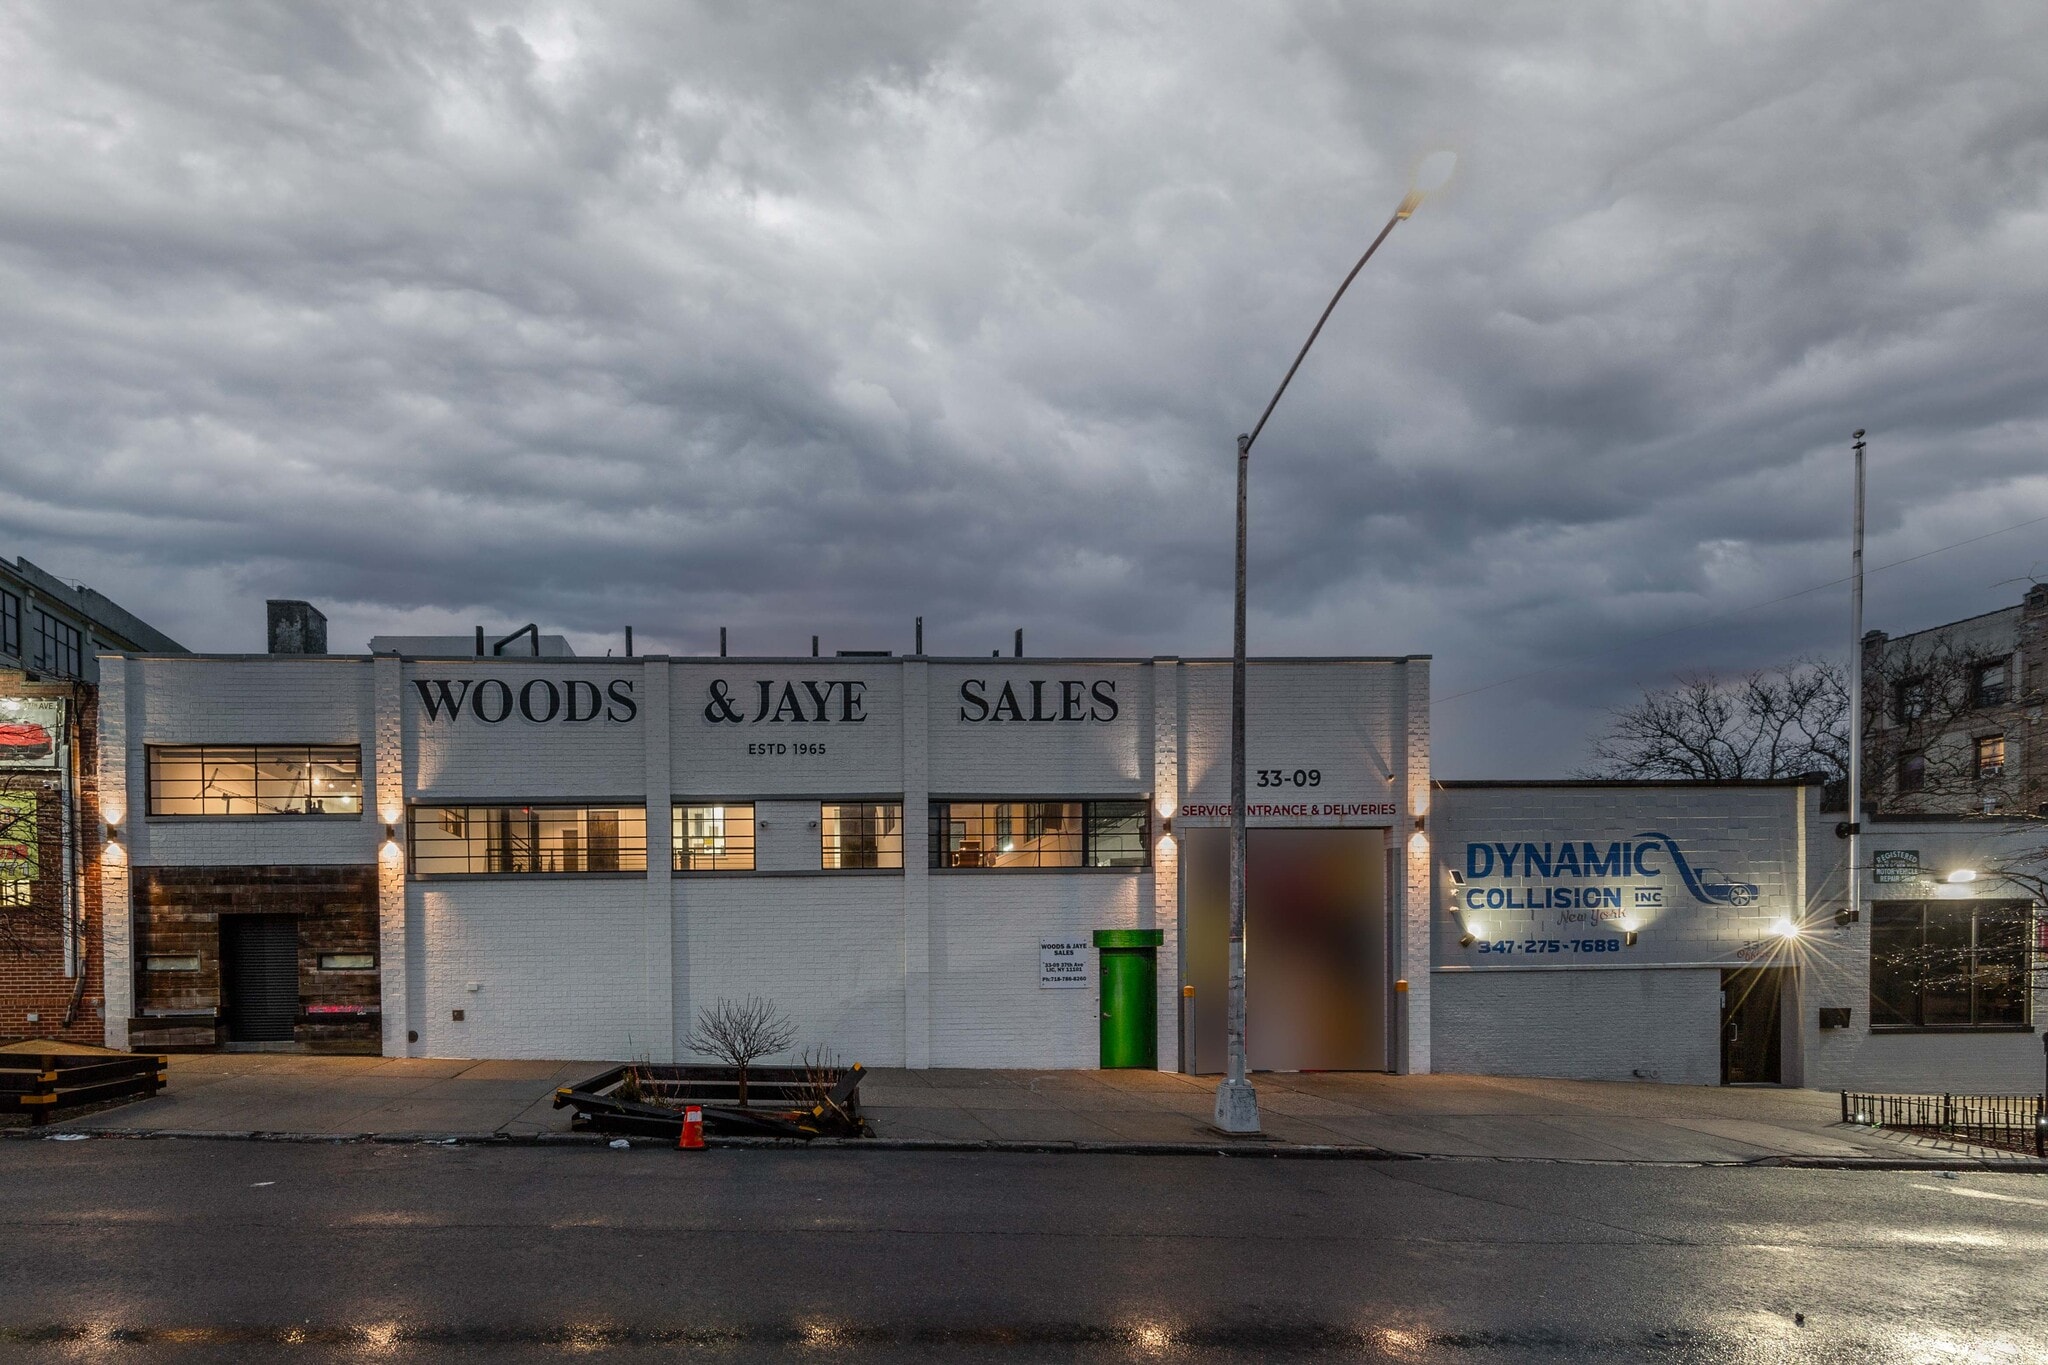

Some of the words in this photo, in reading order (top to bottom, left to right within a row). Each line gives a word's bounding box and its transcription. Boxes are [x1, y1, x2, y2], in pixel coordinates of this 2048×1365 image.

[411, 679, 637, 723] WOODS
[704, 679, 745, 723] &
[752, 680, 868, 723] JAYE
[960, 679, 1119, 722] SALES
[749, 743, 787, 755] ESTD
[794, 743, 826, 755] 1965
[1256, 769, 1321, 787] 33-09
[1247, 804, 1307, 816] NTRANCE
[1311, 805, 1320, 816] &
[1323, 804, 1397, 816] DELIVERIES
[1467, 842, 1661, 878] DYNAMIC
[1876, 851, 1918, 863] REGISTERED
[1466, 887, 1621, 909] COLLISION
[1635, 892, 1662, 902] INC
[1557, 909, 1587, 926] New
